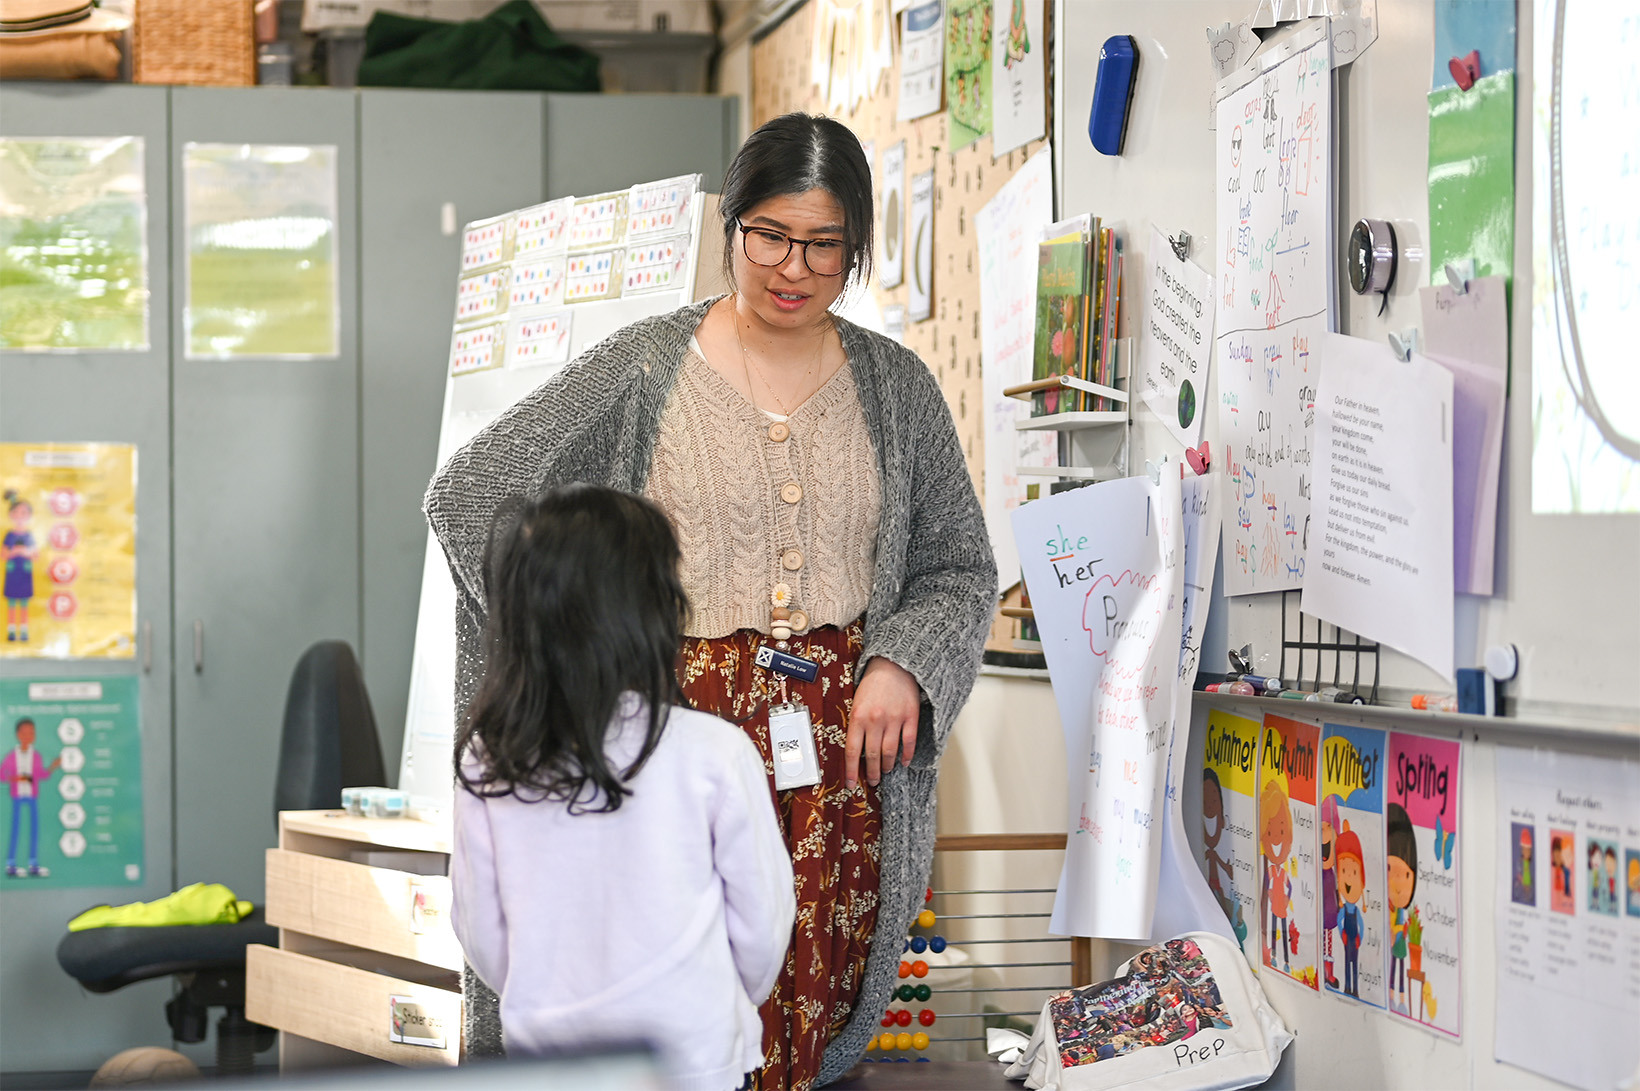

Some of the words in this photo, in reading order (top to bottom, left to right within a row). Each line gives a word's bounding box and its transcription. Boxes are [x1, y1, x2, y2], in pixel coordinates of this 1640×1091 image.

[1155, 261, 1161, 278] In
[1161, 264, 1170, 288] the
[1171, 276, 1203, 319] beginning,
[1152, 289, 1165, 314] God
[1165, 302, 1189, 335] created
[1188, 319, 1201, 346] the
[1150, 317, 1172, 352] heavens
[1173, 341, 1184, 364] and
[1185, 347, 1197, 374] the
[1160, 360, 1177, 388] earth.
[1334, 394, 1342, 405] Our
[1343, 397, 1356, 409] Father
[1332, 408, 1351, 421] hallowed
[1358, 417, 1368, 428] your
[1332, 424, 1340, 434] your
[1341, 426, 1358, 440] kingdom
[1332, 438, 1340, 448] your
[1338, 453, 1348, 463] earth
[1330, 478, 1344, 491] Forgive
[1331, 464, 1340, 474] Give
[1346, 469, 1358, 481] today
[1368, 476, 1376, 487] daily
[1192, 480, 1209, 516] kind
[1342, 495, 1356, 510] forgive
[1356, 501, 1368, 512] those
[1370, 505, 1378, 516] who
[1387, 511, 1402, 525] against
[1328, 507, 1338, 516] Lead
[1352, 515, 1360, 524] into
[1046, 524, 1090, 556] she
[1334, 522, 1348, 534] deliver
[1355, 528, 1366, 540] from
[1322, 562, 1331, 571] now
[1332, 565, 1340, 575] and
[1360, 546, 1368, 556] the
[1385, 554, 1394, 565] and
[1053, 558, 1103, 588] her
[1206, 724, 1256, 772] Summer
[1262, 729, 1314, 779] Autumn
[1326, 744, 1378, 790] Winter
[1396, 752, 1448, 815] Spring
[1224, 814, 1253, 841] December
[1293, 807, 1314, 831] March
[1228, 850, 1255, 879] January
[1299, 846, 1314, 870] April
[1418, 861, 1456, 889] September
[1230, 882, 1256, 910] February
[1301, 881, 1314, 907] May
[1366, 890, 1382, 911] June
[1425, 902, 1456, 928] October
[1366, 927, 1382, 950] July
[1423, 940, 1458, 967] November
[1358, 963, 1382, 991] August
[1173, 1038, 1225, 1067] Prep
